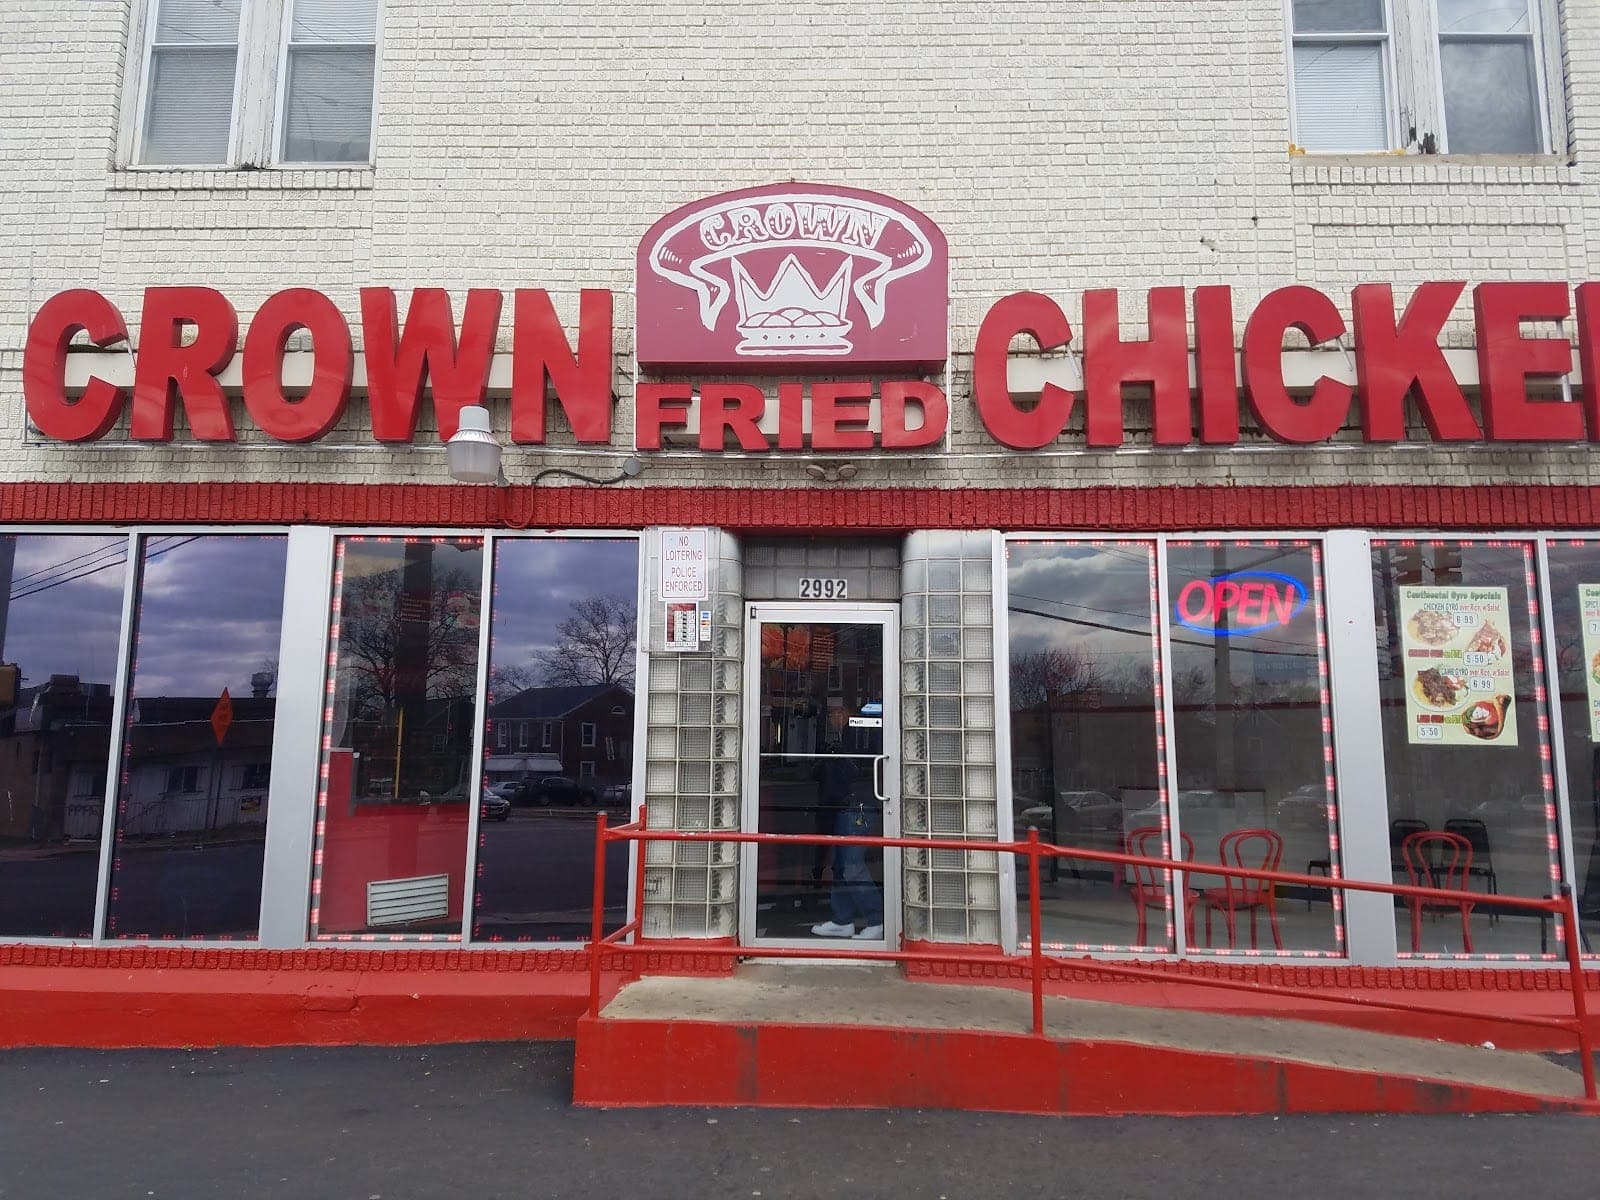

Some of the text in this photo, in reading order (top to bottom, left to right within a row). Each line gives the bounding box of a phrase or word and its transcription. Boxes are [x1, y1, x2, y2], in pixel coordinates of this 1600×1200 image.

[700, 203, 890, 250] CROWN
[23, 287, 613, 444] CROWN
[635, 380, 949, 450] FRIED
[679, 536, 689, 546] NO
[665, 550, 703, 561] LOITERING
[671, 567, 697, 578] POLICE
[665, 581, 703, 592] ENFORCED
[800, 579, 846, 598] 2992
[1470, 591, 1501, 601] Specials
[1177, 579, 1295, 625] OPEN
[1423, 603, 1445, 611] CHICKEN
